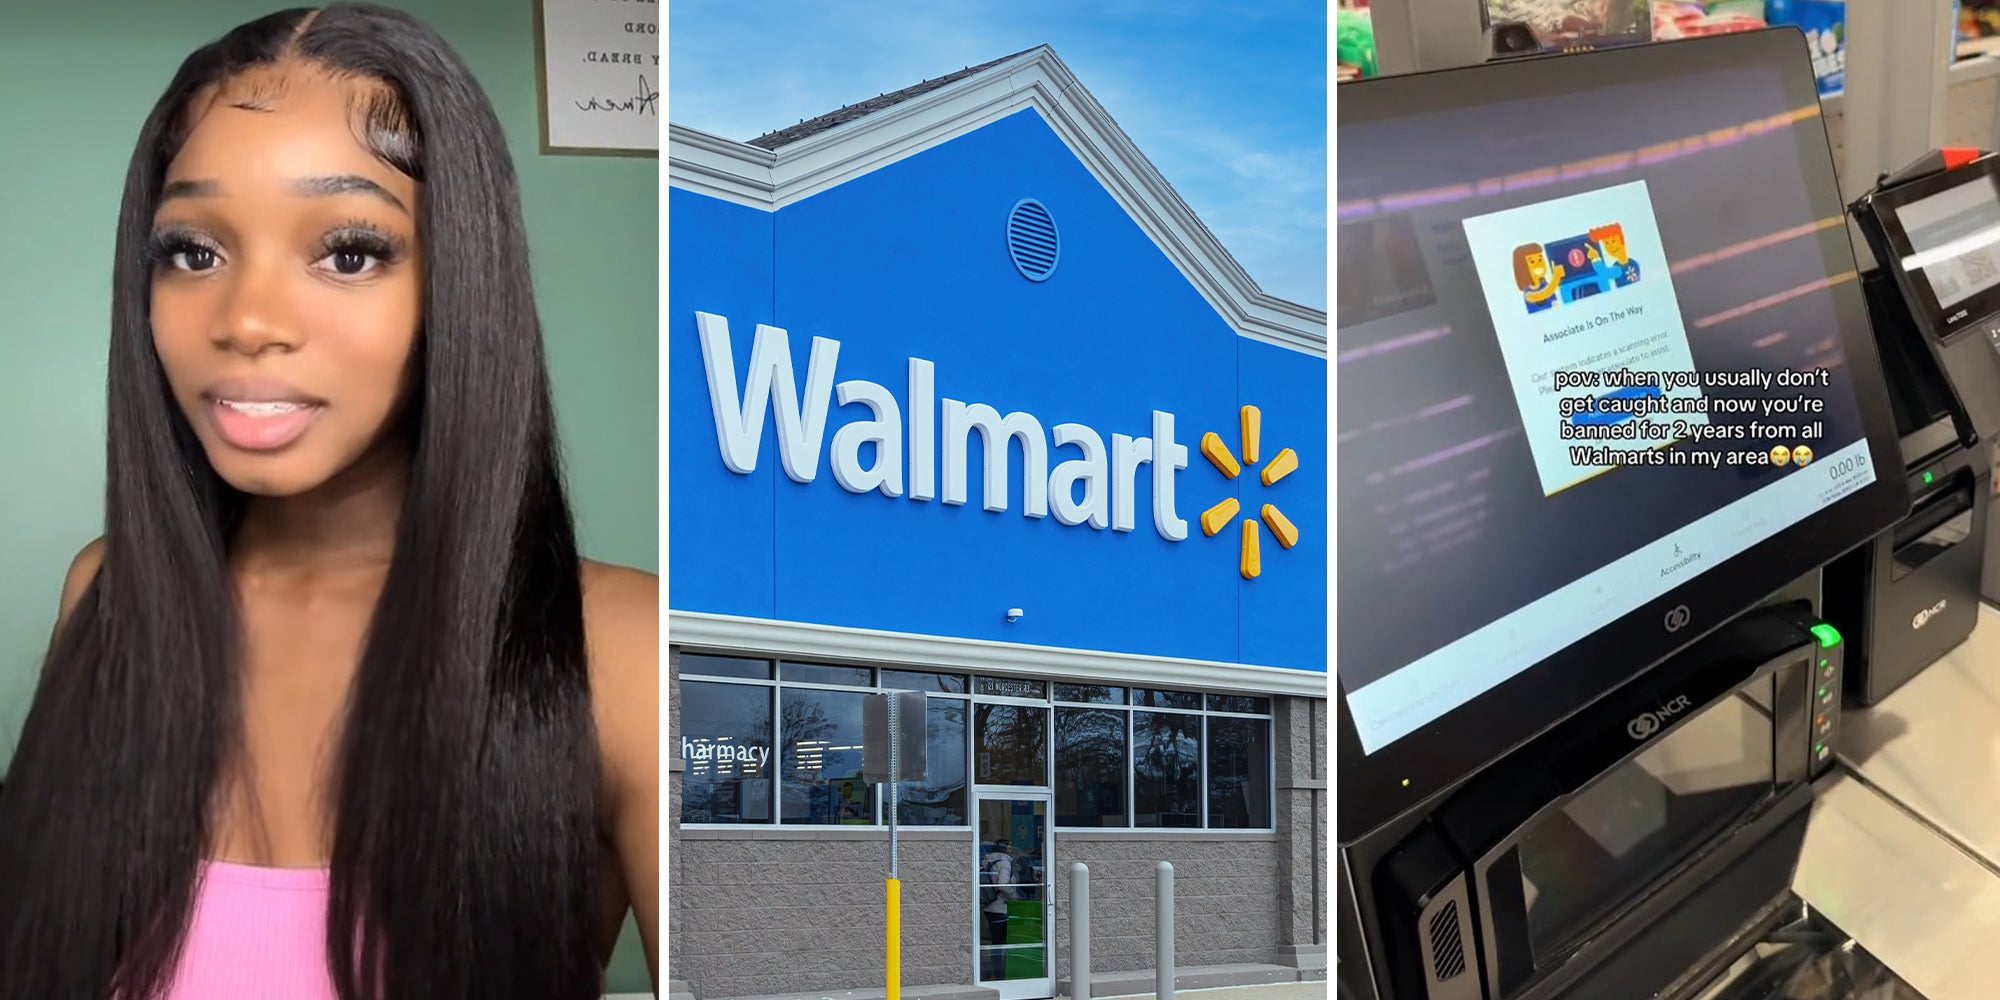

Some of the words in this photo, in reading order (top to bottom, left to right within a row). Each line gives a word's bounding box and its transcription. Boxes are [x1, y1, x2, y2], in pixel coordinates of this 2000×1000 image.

[1543, 325, 1585, 344] Associate
[1586, 320, 1594, 329] Is
[1595, 316, 1609, 326] On
[1610, 312, 1625, 323] The
[1627, 305, 1644, 317] Way
[695, 311, 1188, 541] Walmart
[1829, 458, 1854, 480] 0.00
[1855, 454, 1866, 468] lb
[1660, 552, 1701, 577] Accessibility
[1929, 599, 1947, 617] NCR
[1656, 694, 1692, 721] NCR
[681, 736, 770, 768] harmacy
